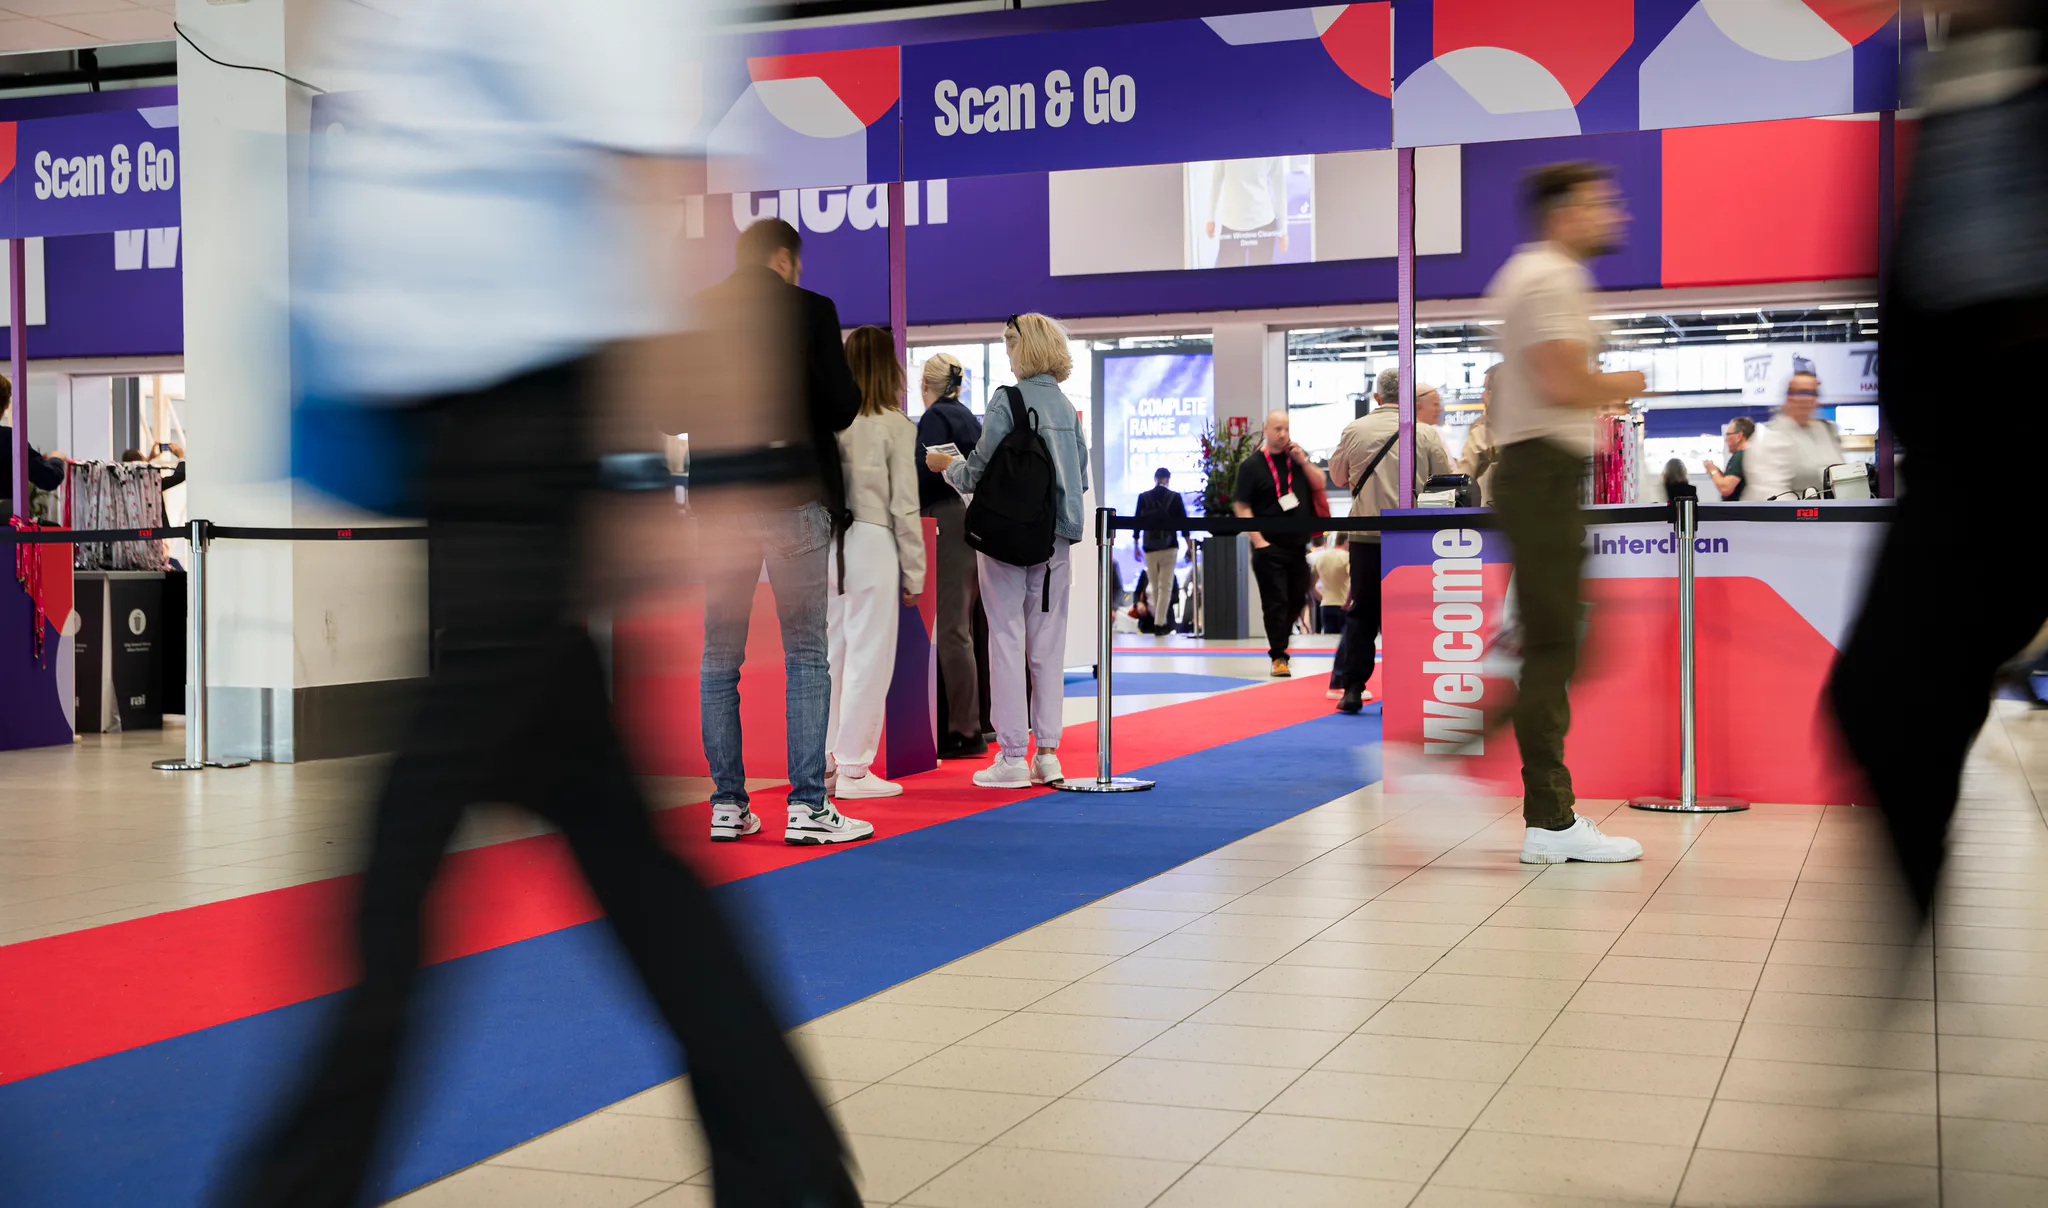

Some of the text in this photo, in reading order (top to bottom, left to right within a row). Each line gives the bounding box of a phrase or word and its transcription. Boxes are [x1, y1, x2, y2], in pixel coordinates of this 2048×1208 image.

[935, 66, 1136, 137] Scan & Go
[34, 141, 175, 200] Scan & Go
[1129, 417, 1176, 436] RANGE
[1140, 397, 1207, 416] COMPLETE
[1593, 531, 1729, 555] Interclan
[1422, 528, 1484, 756] Welcome
